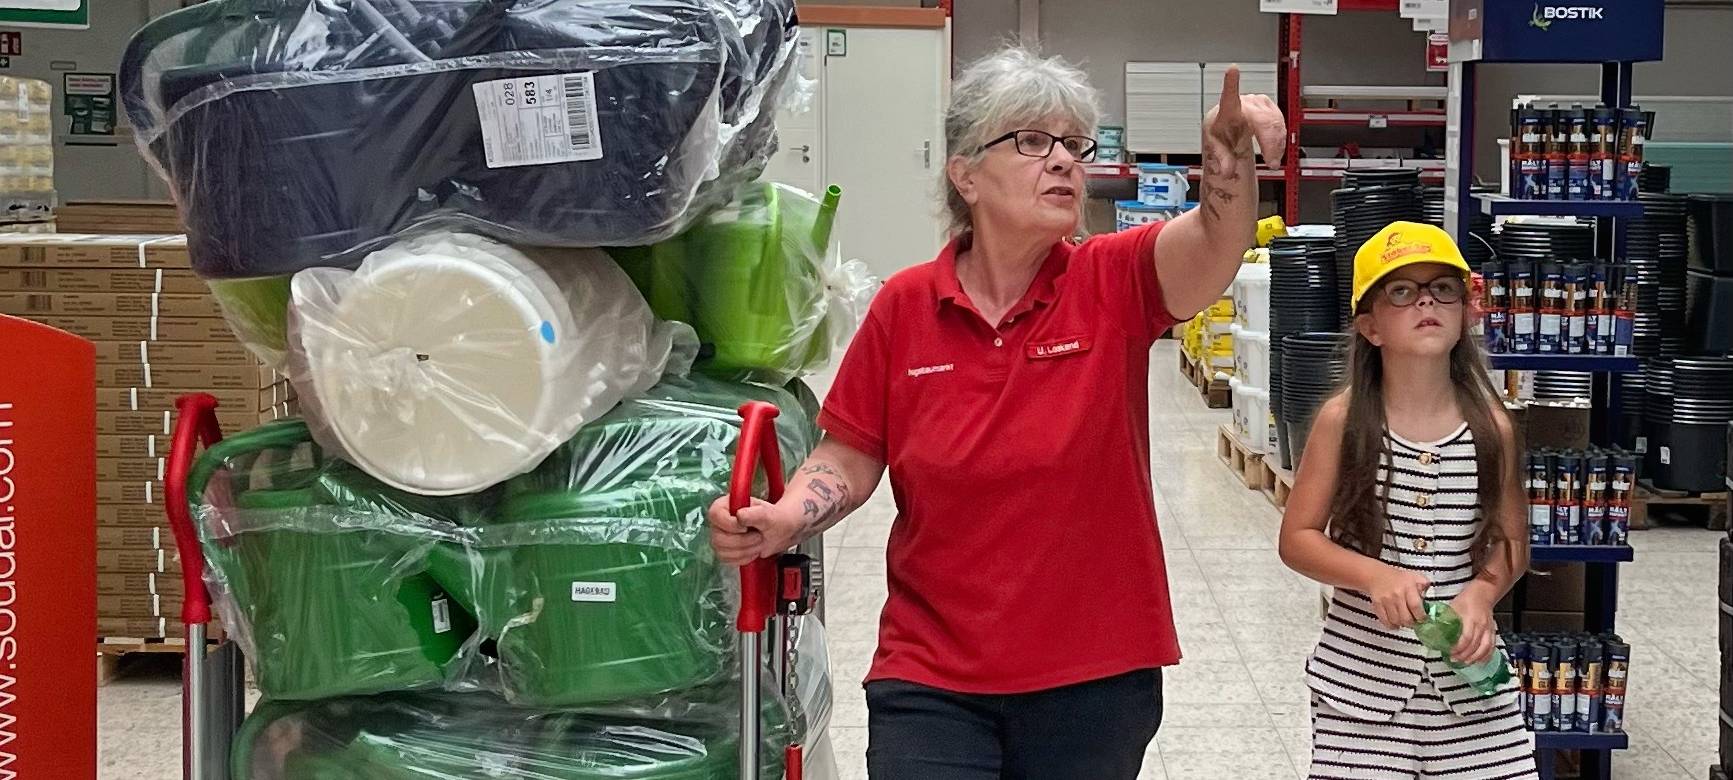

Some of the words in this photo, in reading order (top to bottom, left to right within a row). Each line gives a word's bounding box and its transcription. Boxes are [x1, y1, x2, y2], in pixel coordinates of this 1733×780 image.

[1544, 6, 1603, 19] BOSTIK
[504, 82, 515, 105] 028
[525, 81, 536, 105] 583
